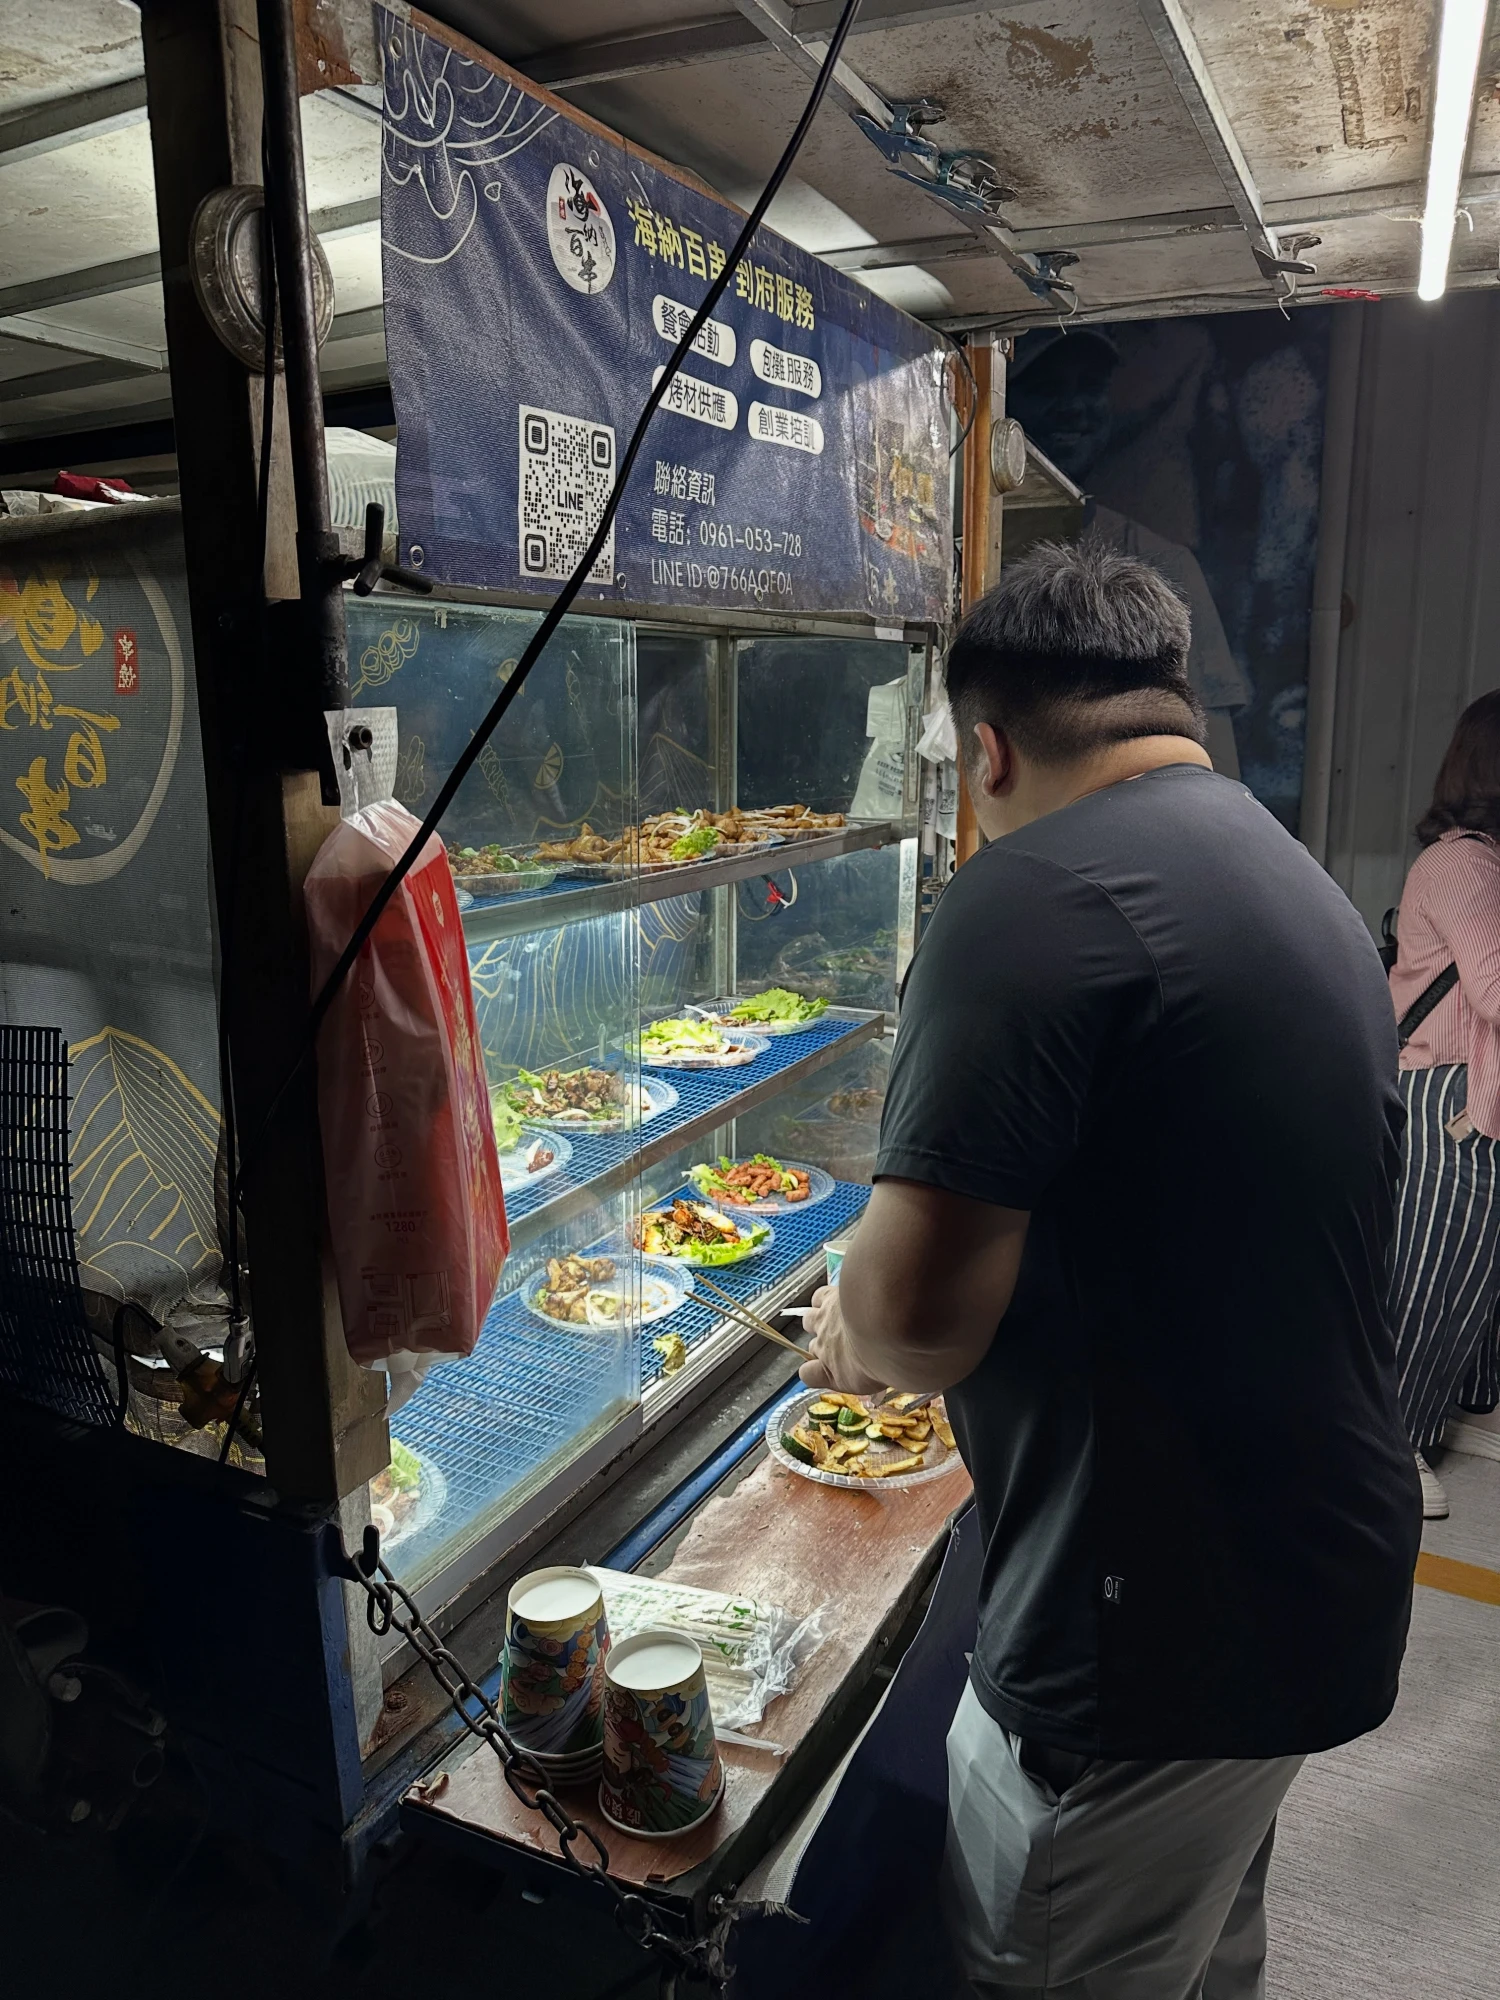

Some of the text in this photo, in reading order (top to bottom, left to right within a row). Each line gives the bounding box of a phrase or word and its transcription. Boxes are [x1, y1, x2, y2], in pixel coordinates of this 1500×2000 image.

[626, 197, 816, 331] 海納百串 到府服務
[763, 346, 814, 391] 包攤服務
[668, 374, 727, 424] 烤材供應
[758, 407, 816, 450] 創業培訓
[557, 489, 584, 511] LINE
[653, 460, 716, 506] 聯絡資訊
[700, 520, 802, 557] 0961-053-728
[651, 558, 684, 587] LINE
[385, 1220, 416, 1233] 1280
